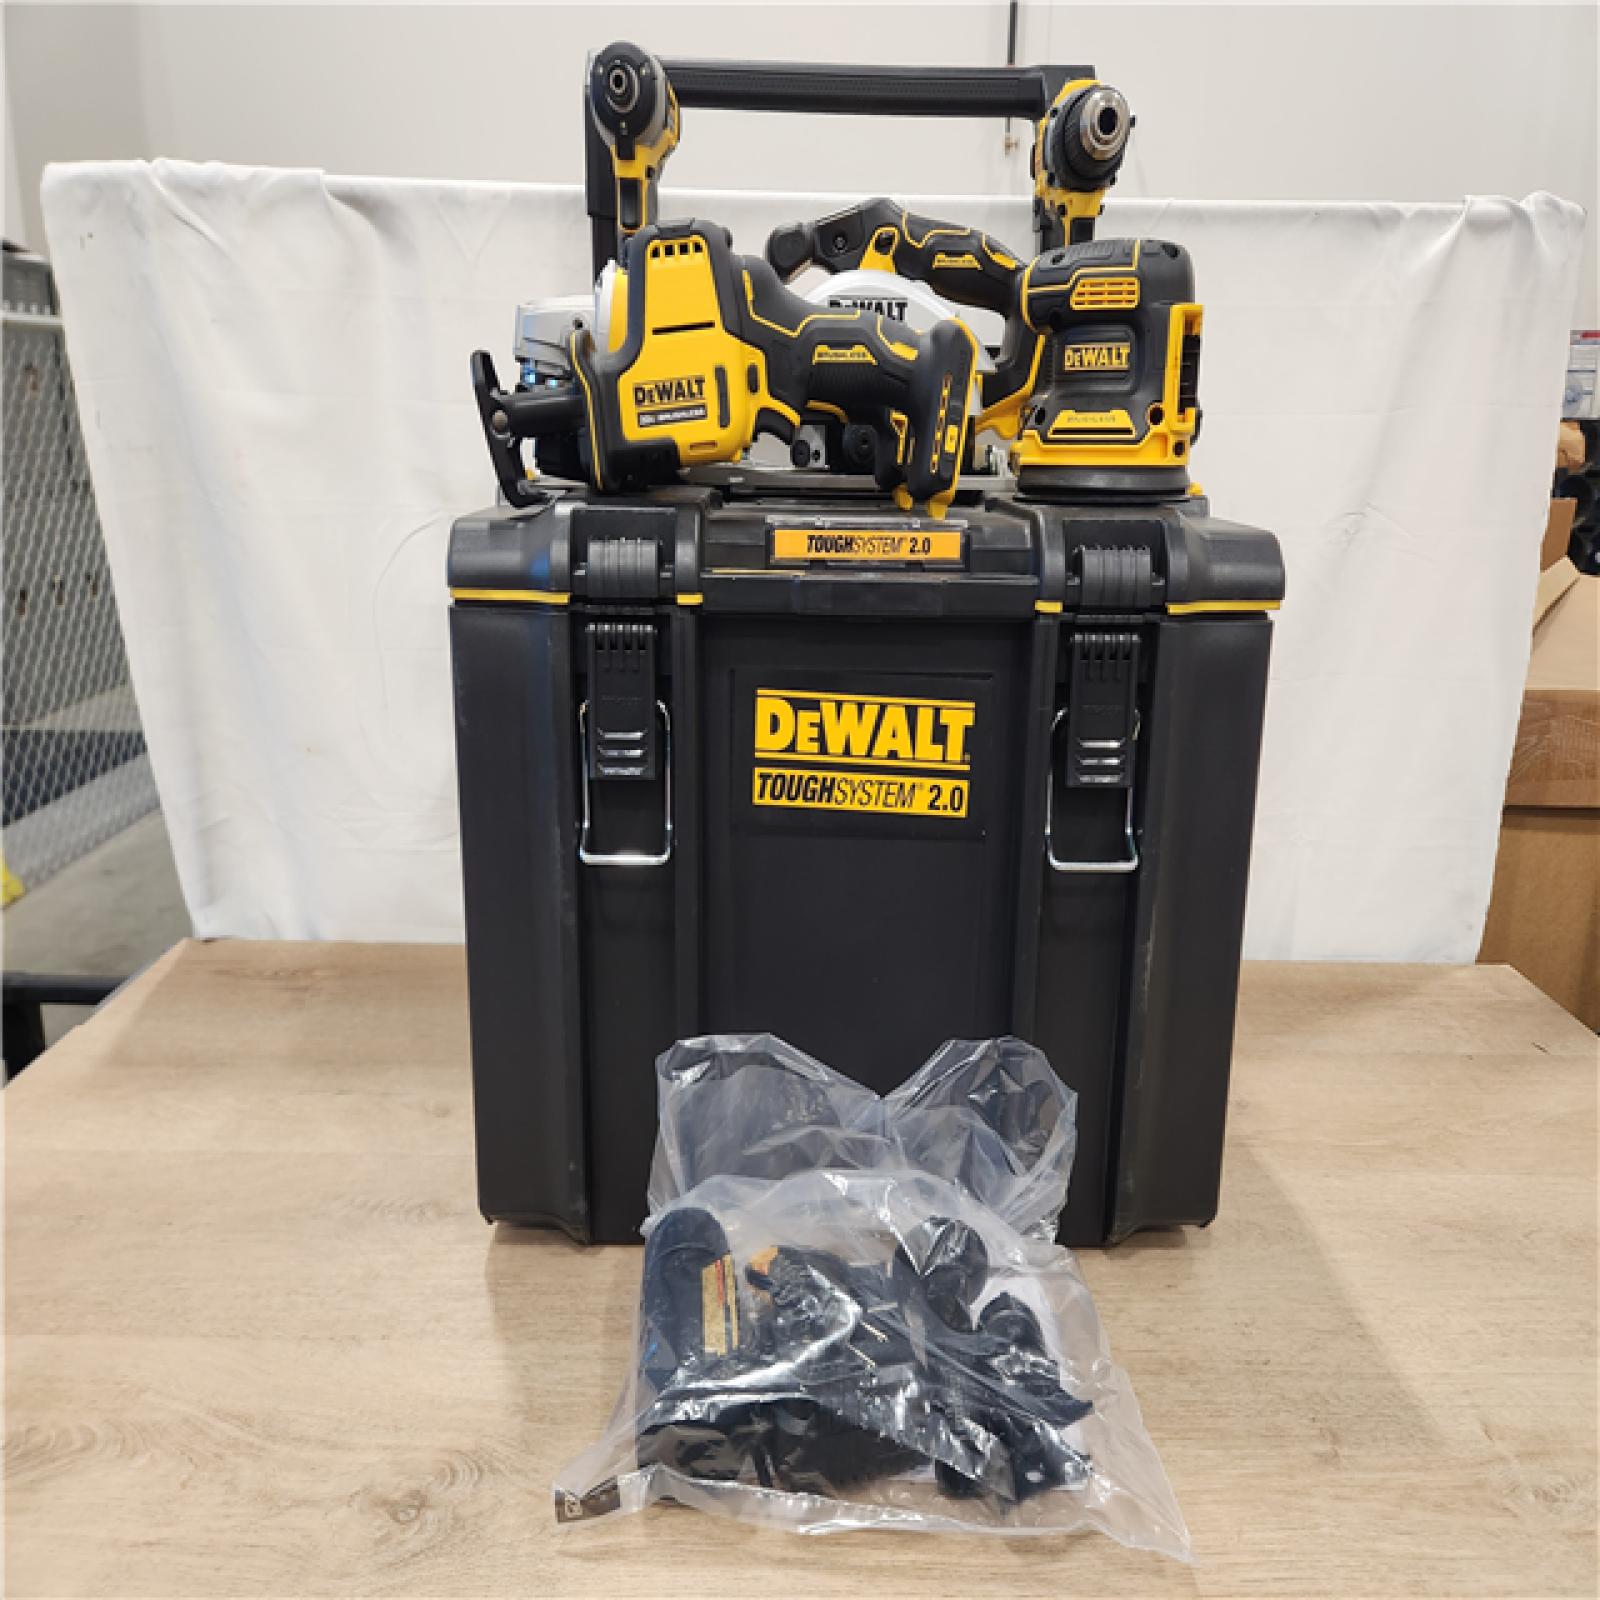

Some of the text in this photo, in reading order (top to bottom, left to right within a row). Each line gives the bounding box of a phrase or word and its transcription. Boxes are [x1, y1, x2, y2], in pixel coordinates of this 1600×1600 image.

[829, 300, 908, 322] ALT
[807, 535, 931, 555] TOUGHSYSTEM 2.0
[755, 697, 975, 761] DEWALT
[757, 772, 964, 813] TOUGHSYSTEM 2.0
